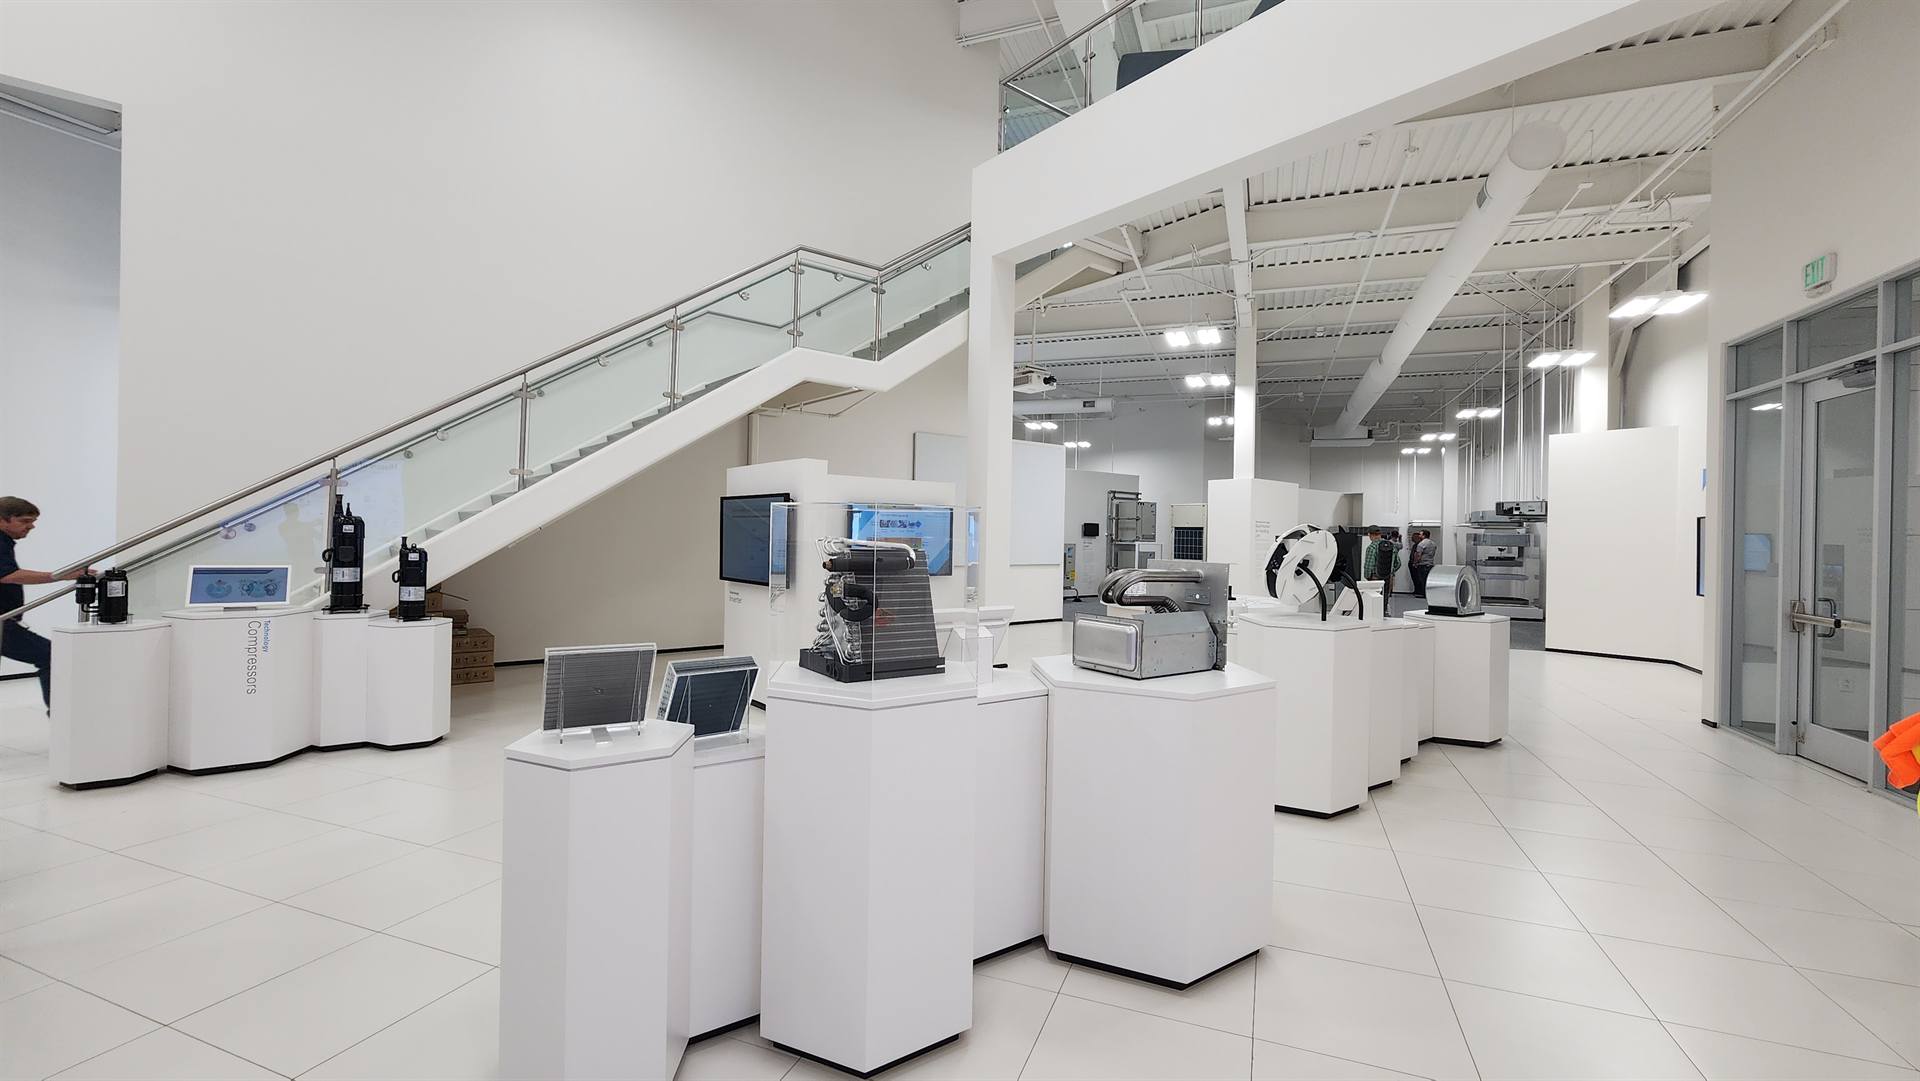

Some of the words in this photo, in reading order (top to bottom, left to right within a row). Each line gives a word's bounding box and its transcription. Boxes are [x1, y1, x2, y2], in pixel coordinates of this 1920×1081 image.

[1805, 257, 1825, 287] EXIT
[262, 620, 271, 653] Technology
[245, 621, 261, 695] Compressors
